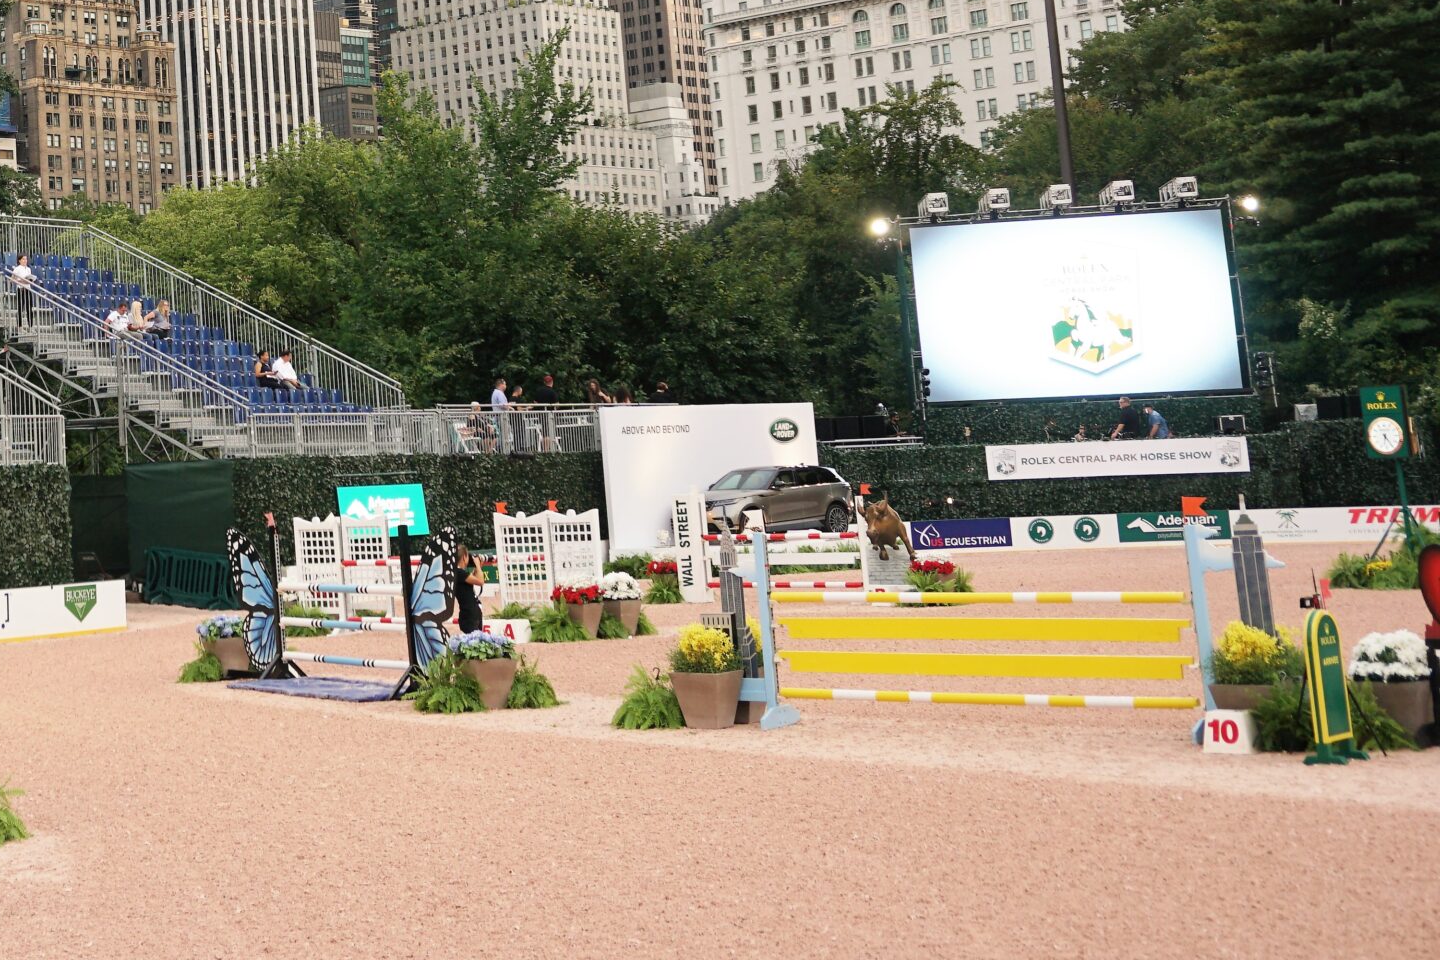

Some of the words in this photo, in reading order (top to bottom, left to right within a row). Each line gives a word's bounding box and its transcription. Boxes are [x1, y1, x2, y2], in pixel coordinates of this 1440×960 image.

[1366, 401, 1397, 410] ROLEX
[621, 425, 644, 435] ABOVE
[646, 425, 661, 434] AND
[662, 424, 690, 434] BEYOND
[774, 422, 790, 431] LAND
[775, 430, 795, 439] ROVER
[1021, 455, 1055, 466] ROLEX
[1058, 454, 1107, 464] CENTRAL
[1109, 453, 1138, 463] PARK
[1140, 451, 1177, 461] HORSE
[1179, 450, 1212, 460] SHOW
[675, 500, 691, 548] STREET
[930, 538, 944, 547] US
[945, 535, 1007, 547] EQUESTRIAN
[680, 554, 694, 587] WALL
[66, 588, 96, 602] BUCKEYE
[1207, 719, 1240, 745] 10
